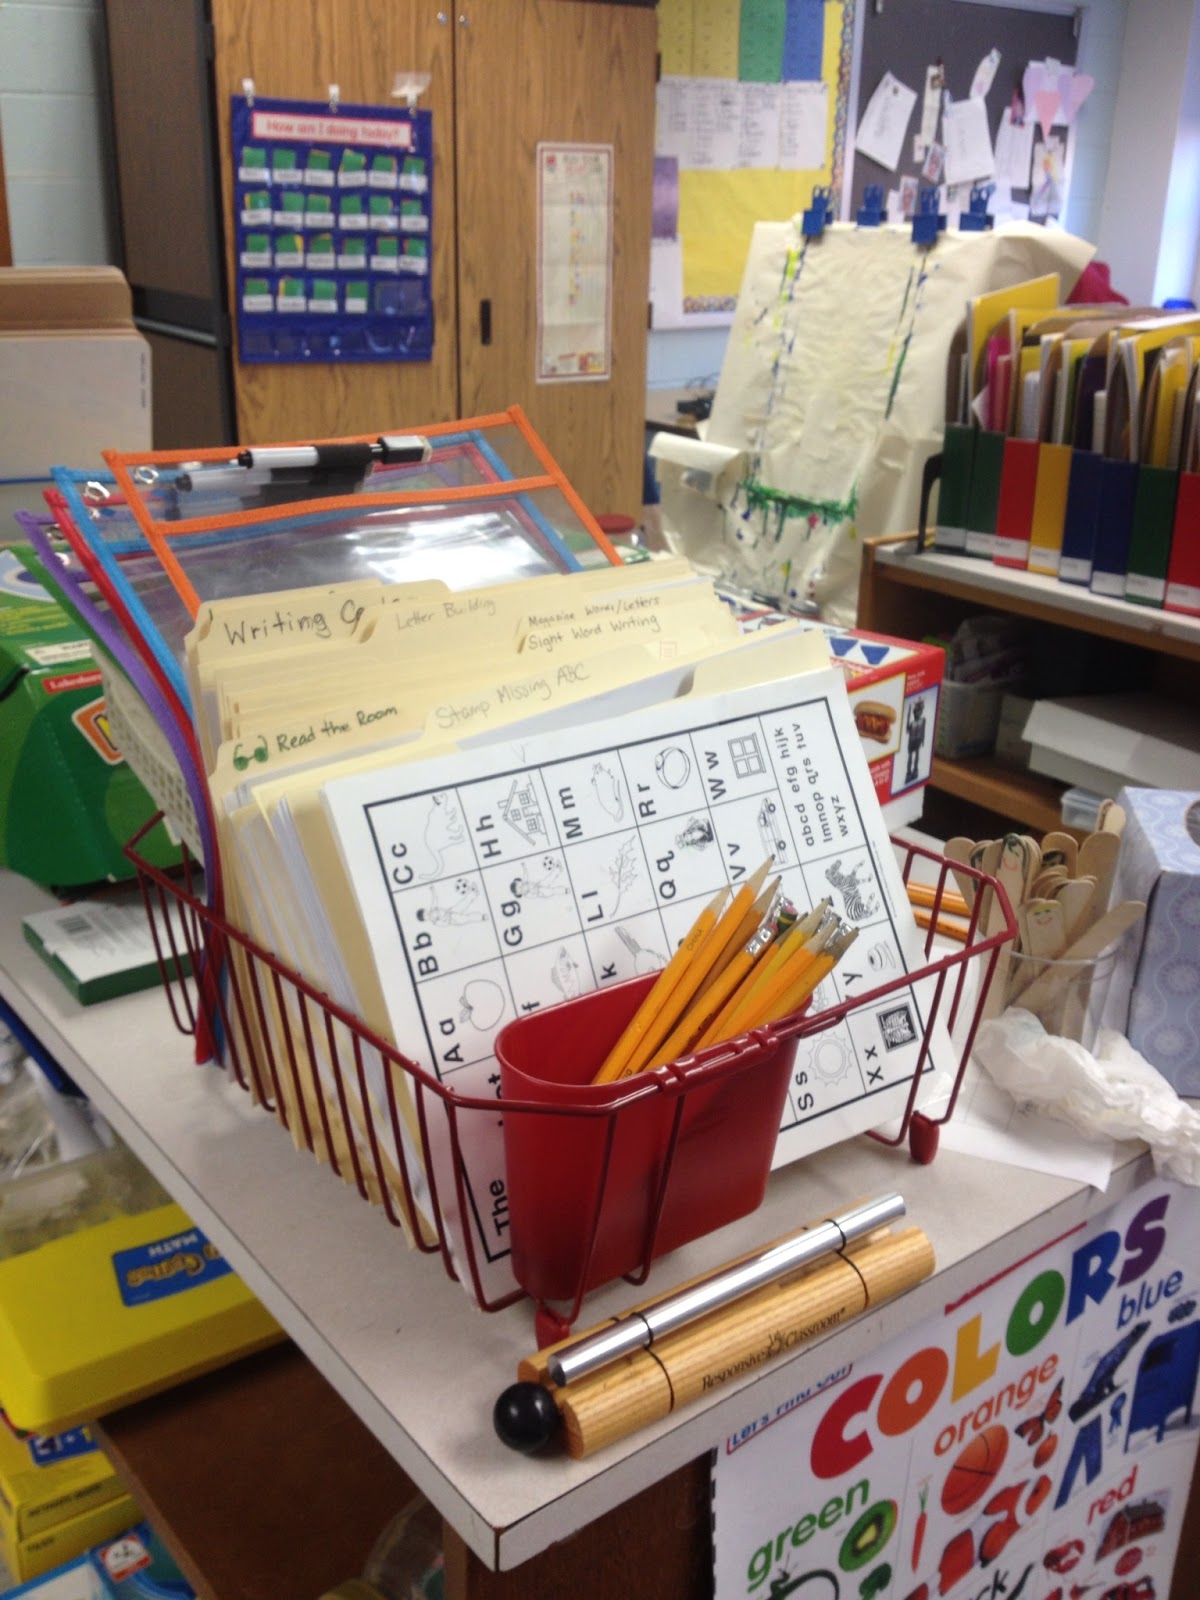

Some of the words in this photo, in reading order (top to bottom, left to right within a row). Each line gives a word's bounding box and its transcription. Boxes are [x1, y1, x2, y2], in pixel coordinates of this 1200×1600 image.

[224, 610, 331, 645] Writing
[528, 631, 563, 652] Sight
[572, 623, 602, 640] Word
[610, 614, 661, 633] Writing
[435, 700, 491, 729] Stamp
[496, 679, 552, 703] Missing
[557, 662, 590, 686] ABC
[276, 726, 316, 752] Read
[320, 718, 351, 738] the
[356, 706, 399, 727] Room
[786, 766, 800, 794] efg
[795, 802, 815, 847] abcd
[830, 795, 849, 838] wxyz
[1116, 1270, 1184, 1331] blue
[810, 1193, 1170, 1480] COLORS
[702, 1350, 769, 1391] Responsive
[933, 1354, 1058, 1457] orange
[1086, 1465, 1138, 1525] red
[747, 1478, 870, 1594] green
